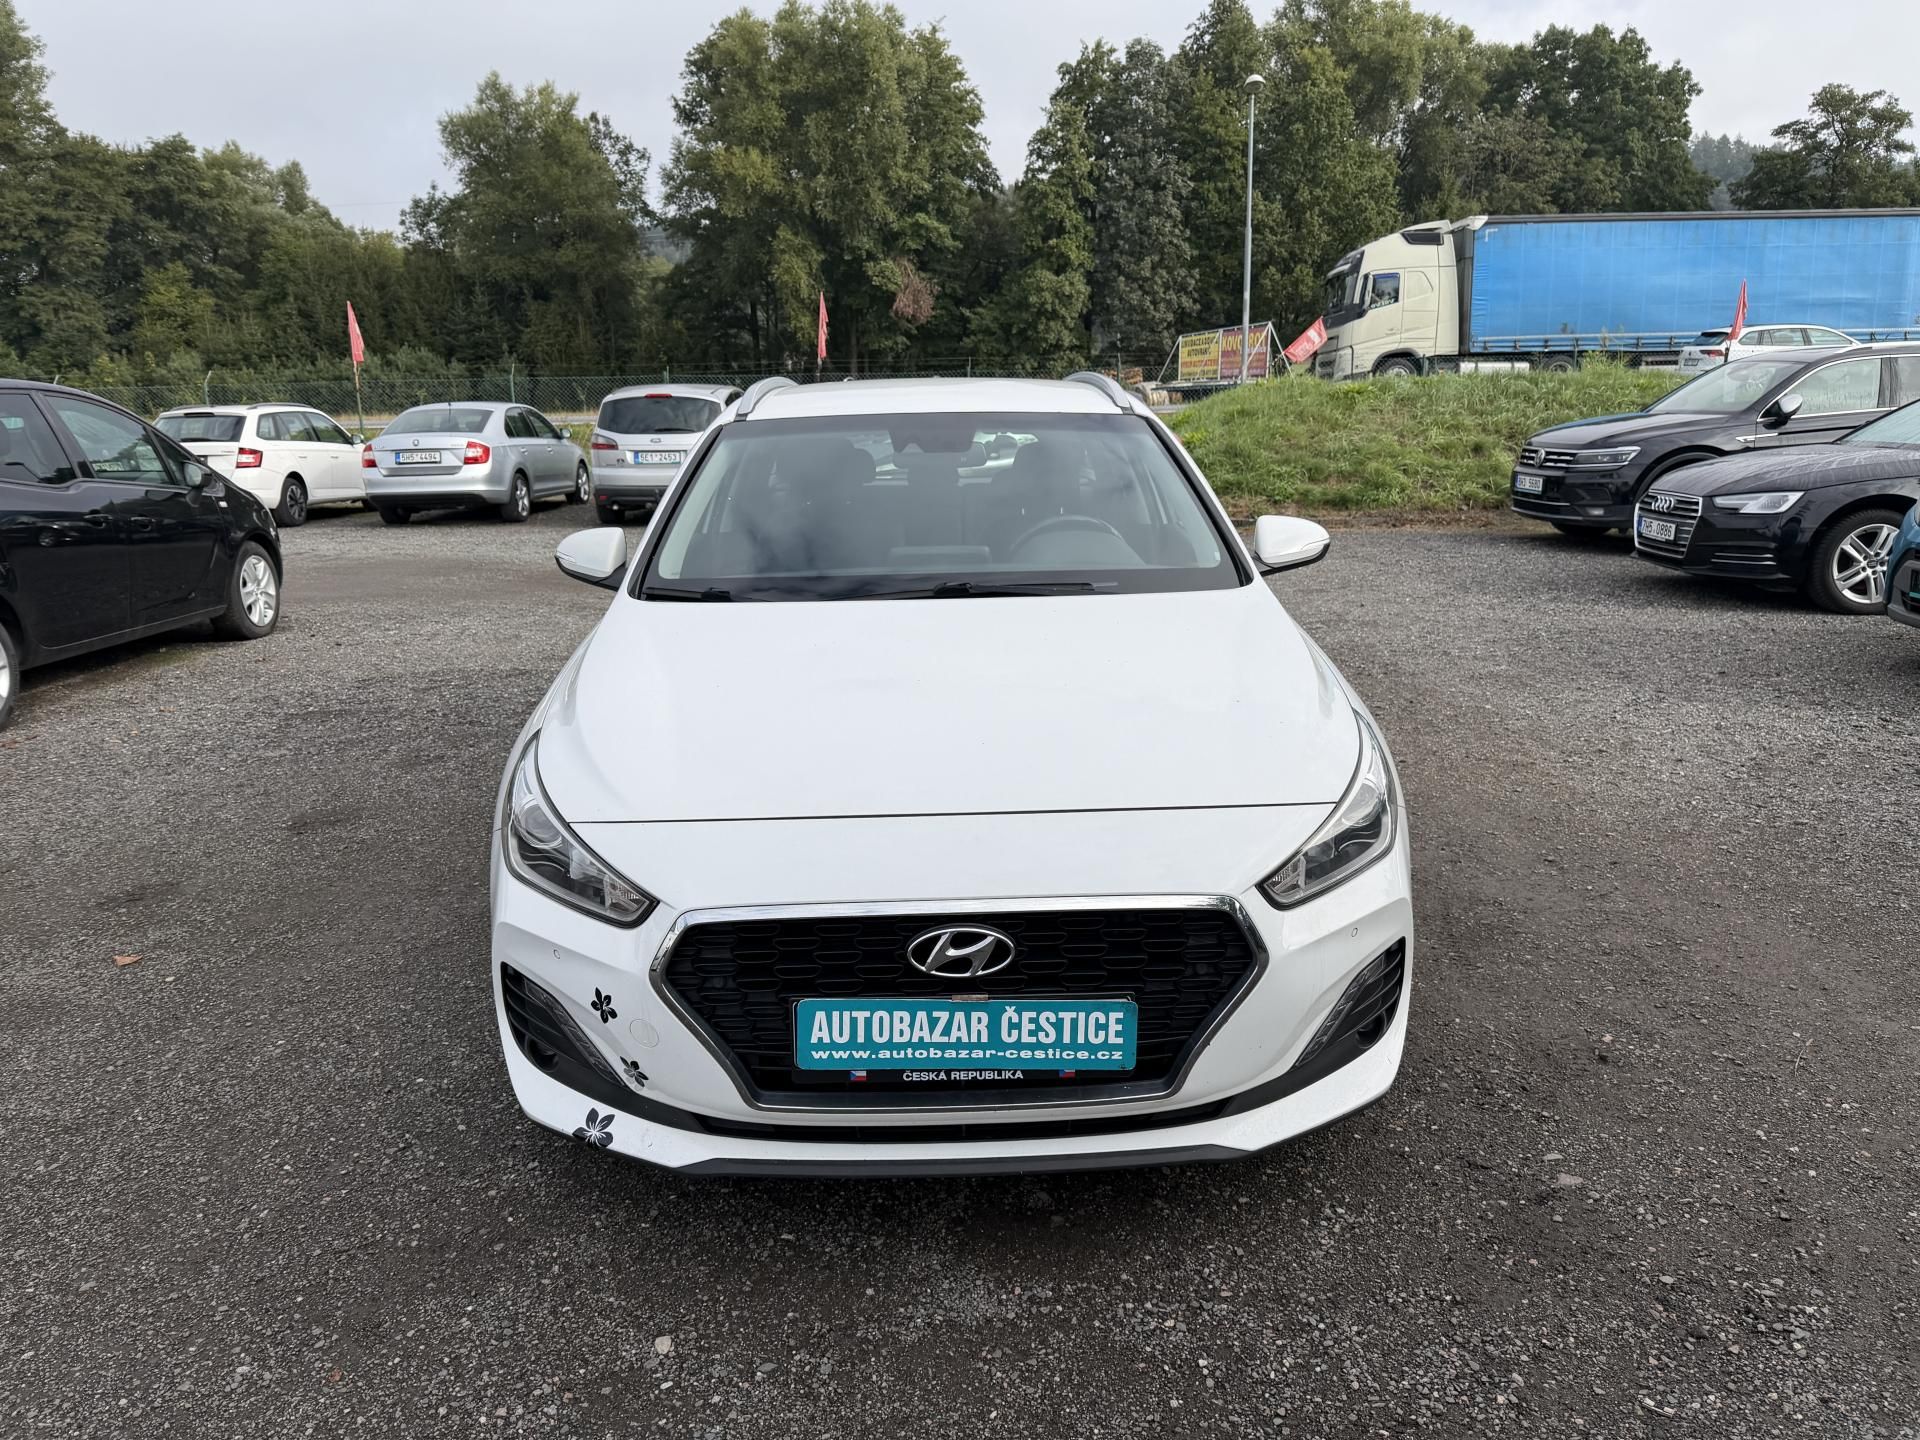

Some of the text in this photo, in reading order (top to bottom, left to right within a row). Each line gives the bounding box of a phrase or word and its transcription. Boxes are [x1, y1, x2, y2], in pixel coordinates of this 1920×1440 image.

[810, 1005, 1125, 1044] AUTOBAZAR ČESTICE
[810, 1048, 1123, 1060] www.autobazar-cestice.cz
[902, 1069, 1024, 1081] ČESKÁ REPUBLIKA
